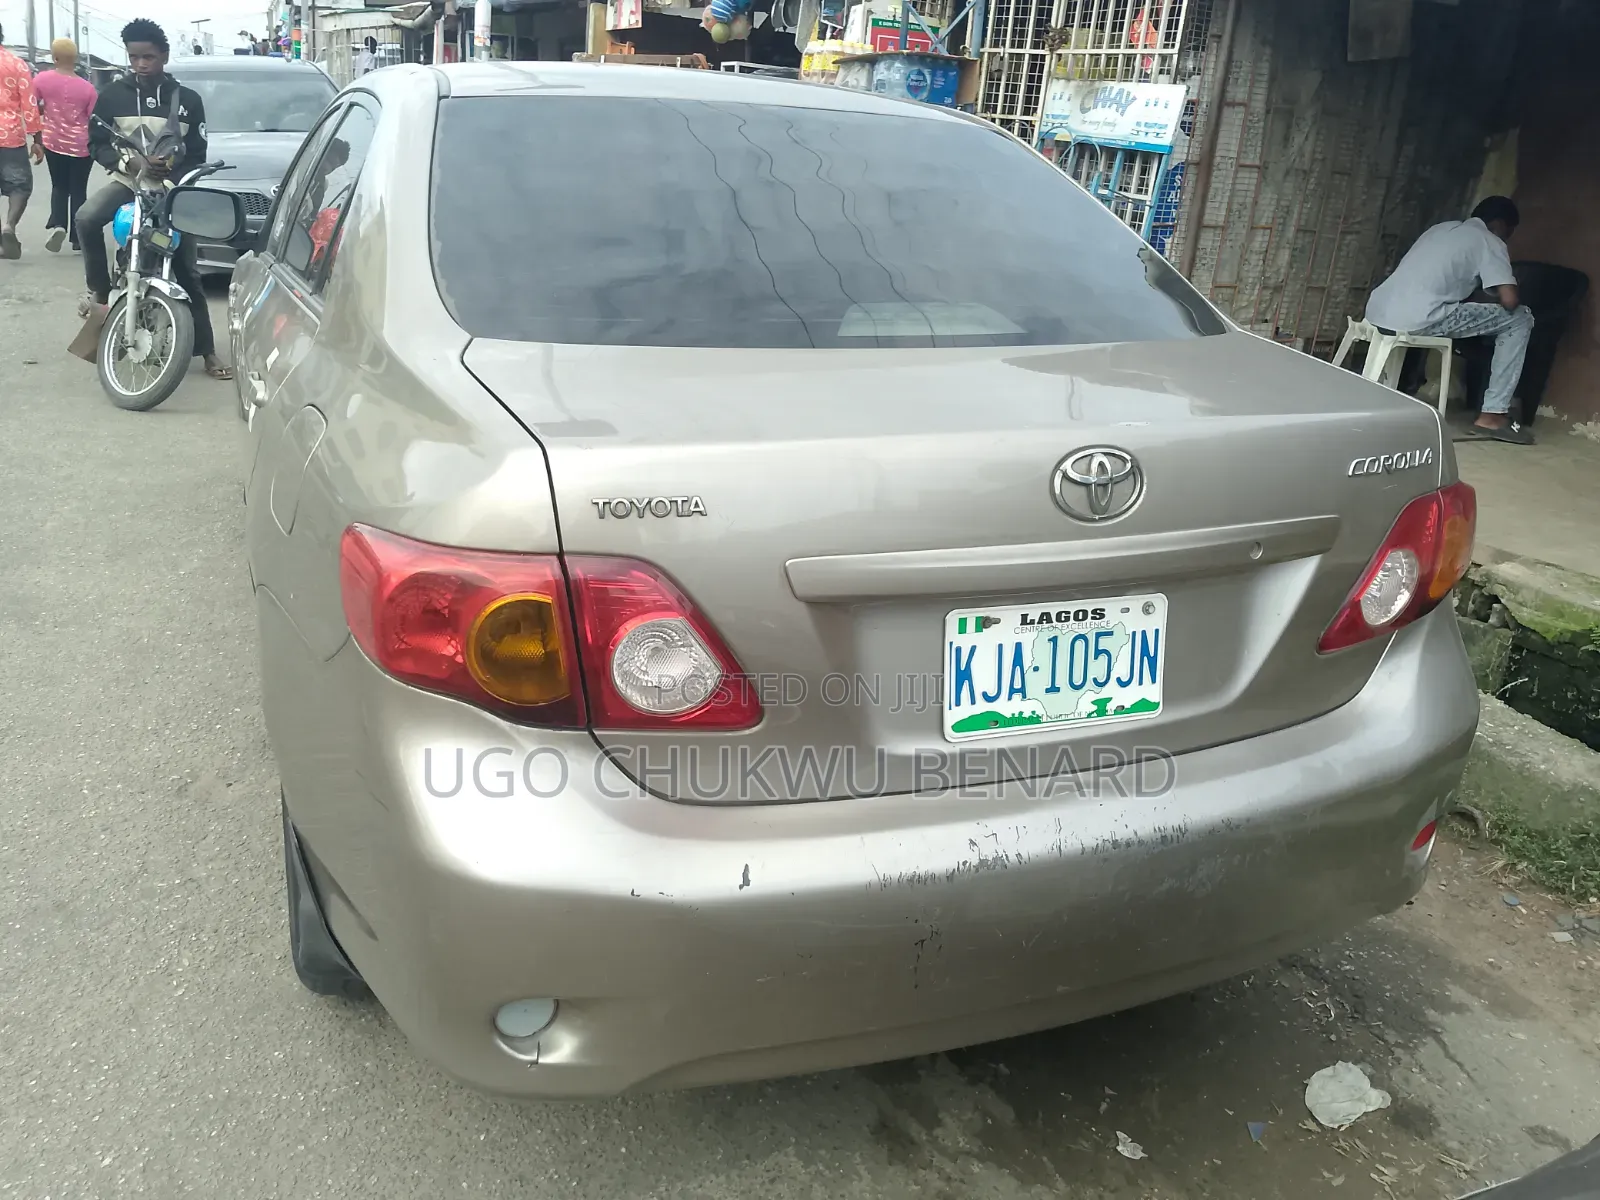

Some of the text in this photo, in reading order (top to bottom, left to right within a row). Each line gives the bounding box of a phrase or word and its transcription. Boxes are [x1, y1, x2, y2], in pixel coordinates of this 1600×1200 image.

[1079, 85, 1138, 117] CWAY
[1347, 447, 1432, 477] COROLLA
[591, 495, 707, 519] TOYOTA
[1013, 619, 1111, 635] CENTRE OF EXCELLENCE
[1019, 607, 1106, 626] LAGOS
